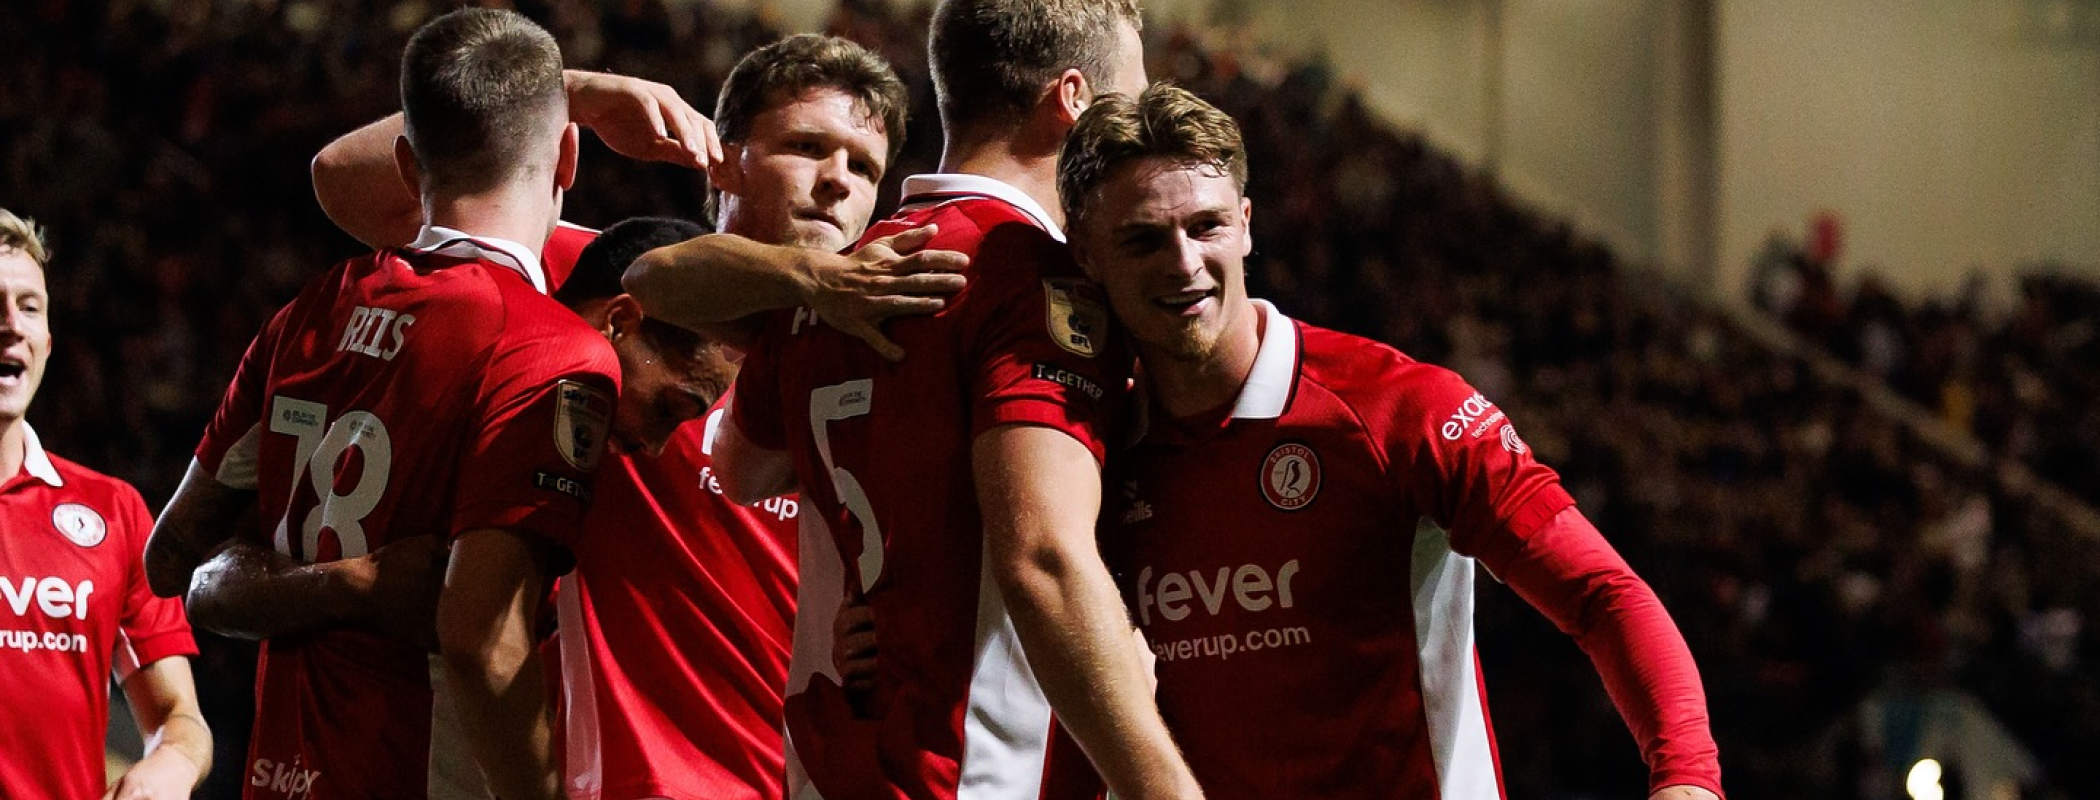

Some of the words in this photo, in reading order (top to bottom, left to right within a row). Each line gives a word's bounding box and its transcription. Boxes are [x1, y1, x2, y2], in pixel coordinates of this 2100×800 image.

[336, 305, 416, 362] RIIS
[1269, 446, 1310, 464] BRISTOL
[809, 378, 884, 594] 5
[1280, 495, 1307, 506] CITY
[0, 576, 94, 620] ver
[1137, 559, 1300, 626] fever
